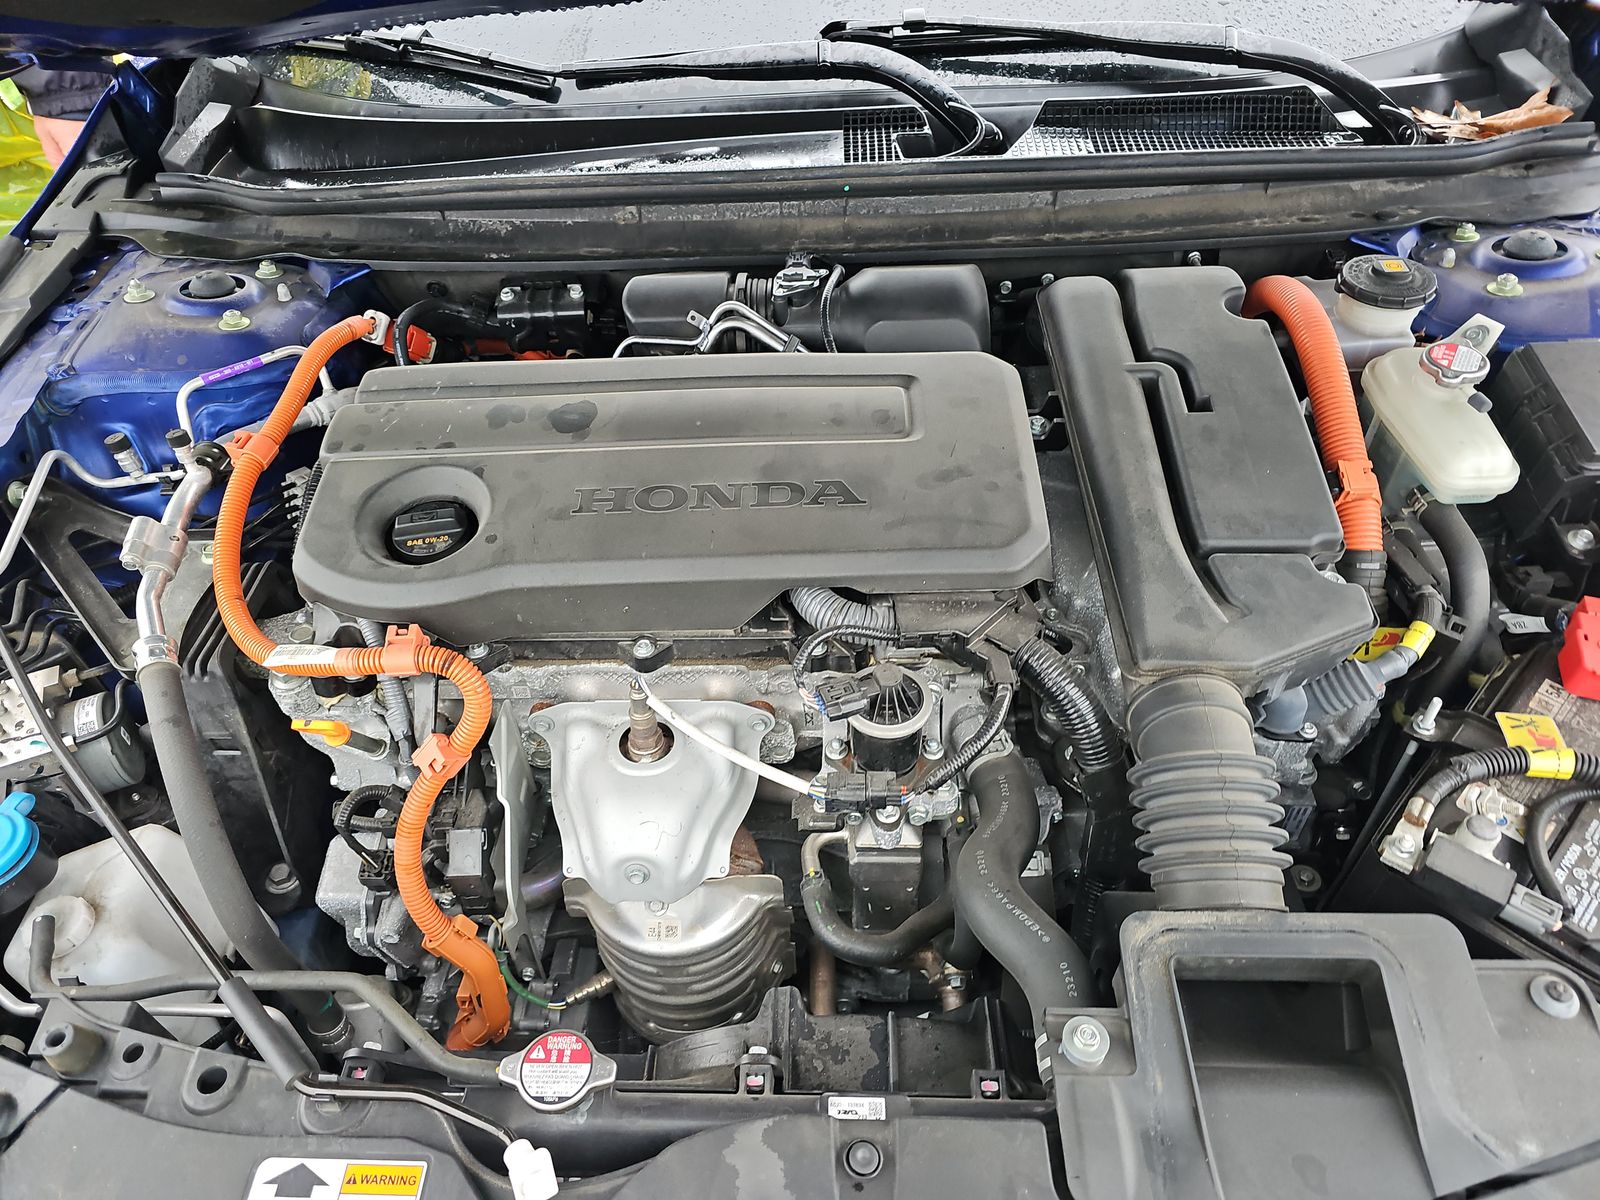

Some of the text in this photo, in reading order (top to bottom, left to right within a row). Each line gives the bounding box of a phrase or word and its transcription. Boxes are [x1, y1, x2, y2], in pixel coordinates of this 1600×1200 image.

[570, 480, 867, 514] HONDA
[406, 535, 449, 546] SAE 0W-20
[1059, 961, 1078, 998] 23210
[547, 1042, 582, 1050] WARNUNG
[360, 1174, 417, 1186] WARNING
